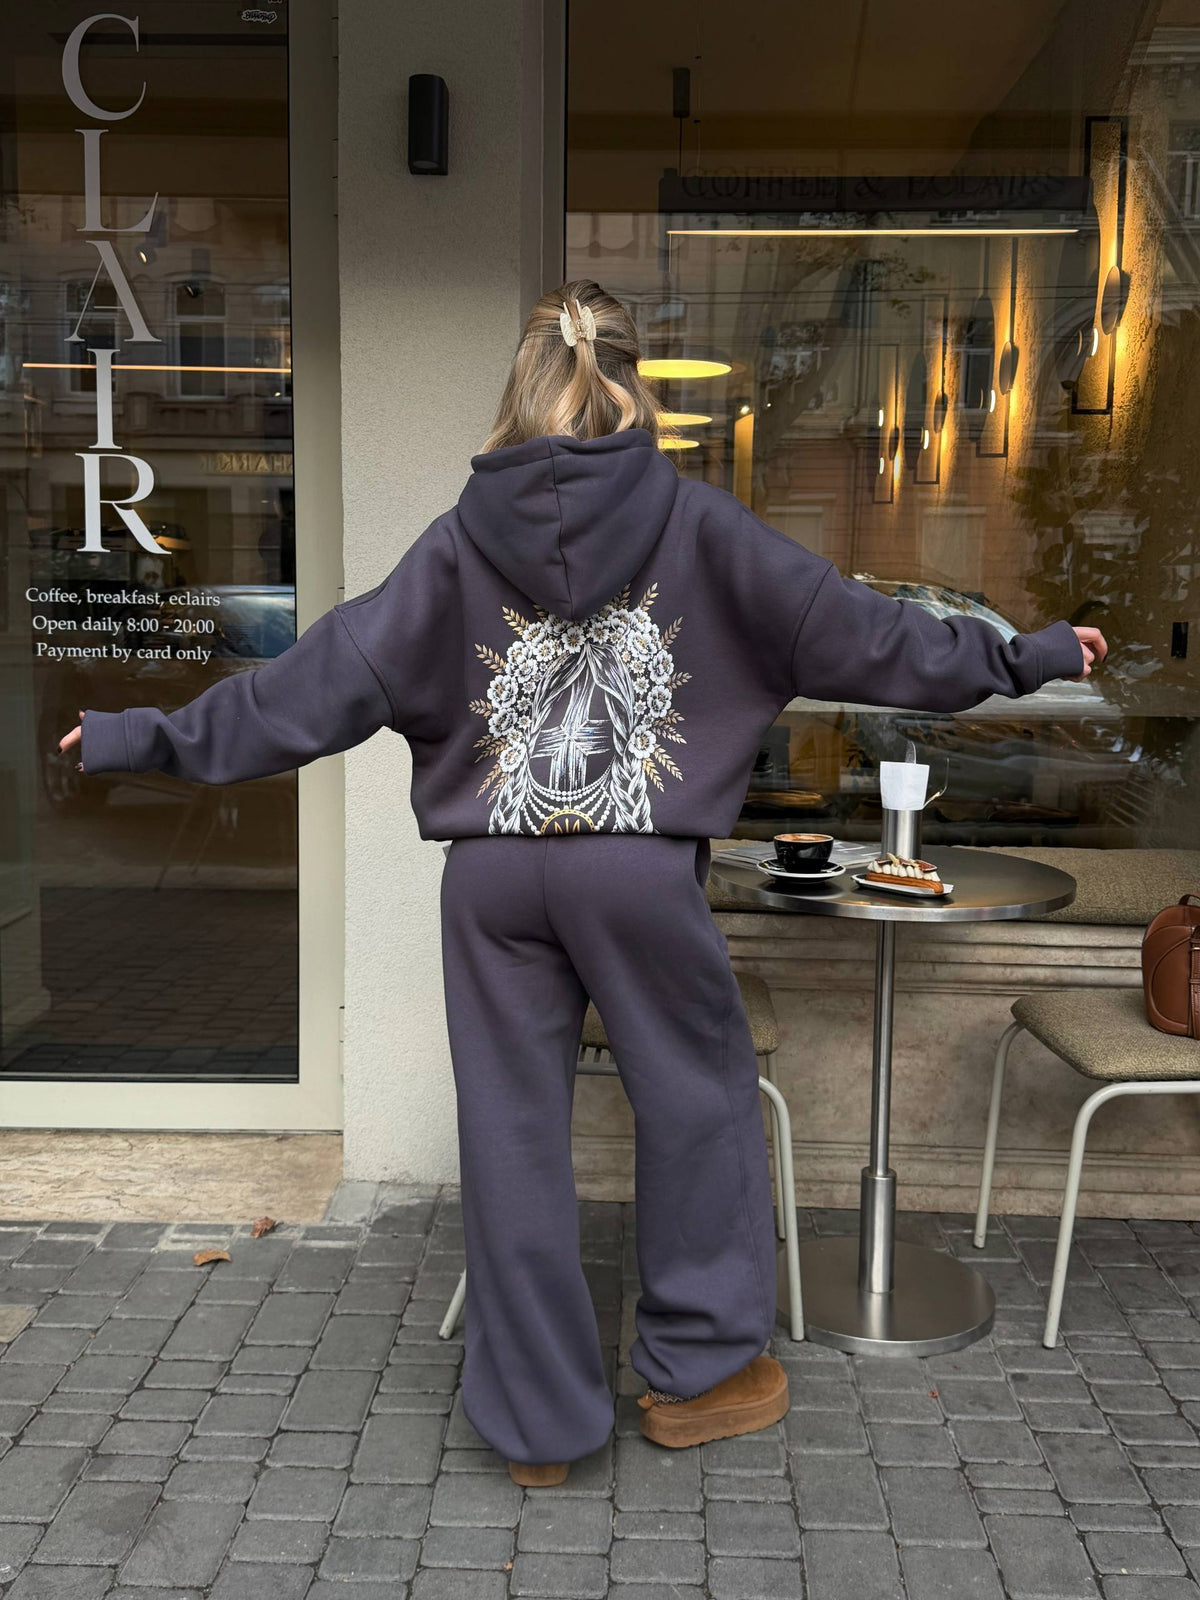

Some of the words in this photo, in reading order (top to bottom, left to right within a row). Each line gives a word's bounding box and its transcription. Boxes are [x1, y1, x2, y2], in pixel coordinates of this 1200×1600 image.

[61, 14, 172, 554] CLAIR
[25, 587, 82, 605] Coffee,
[86, 589, 165, 607] breakfast,
[168, 591, 221, 606] eclairs
[32, 615, 77, 634] Open
[81, 617, 122, 636] daily
[126, 618, 159, 632] 8:00
[173, 619, 215, 633] 20:00
[36, 642, 108, 662] Payment
[111, 644, 132, 663] by
[136, 645, 171, 660] card
[176, 646, 212, 665] only
